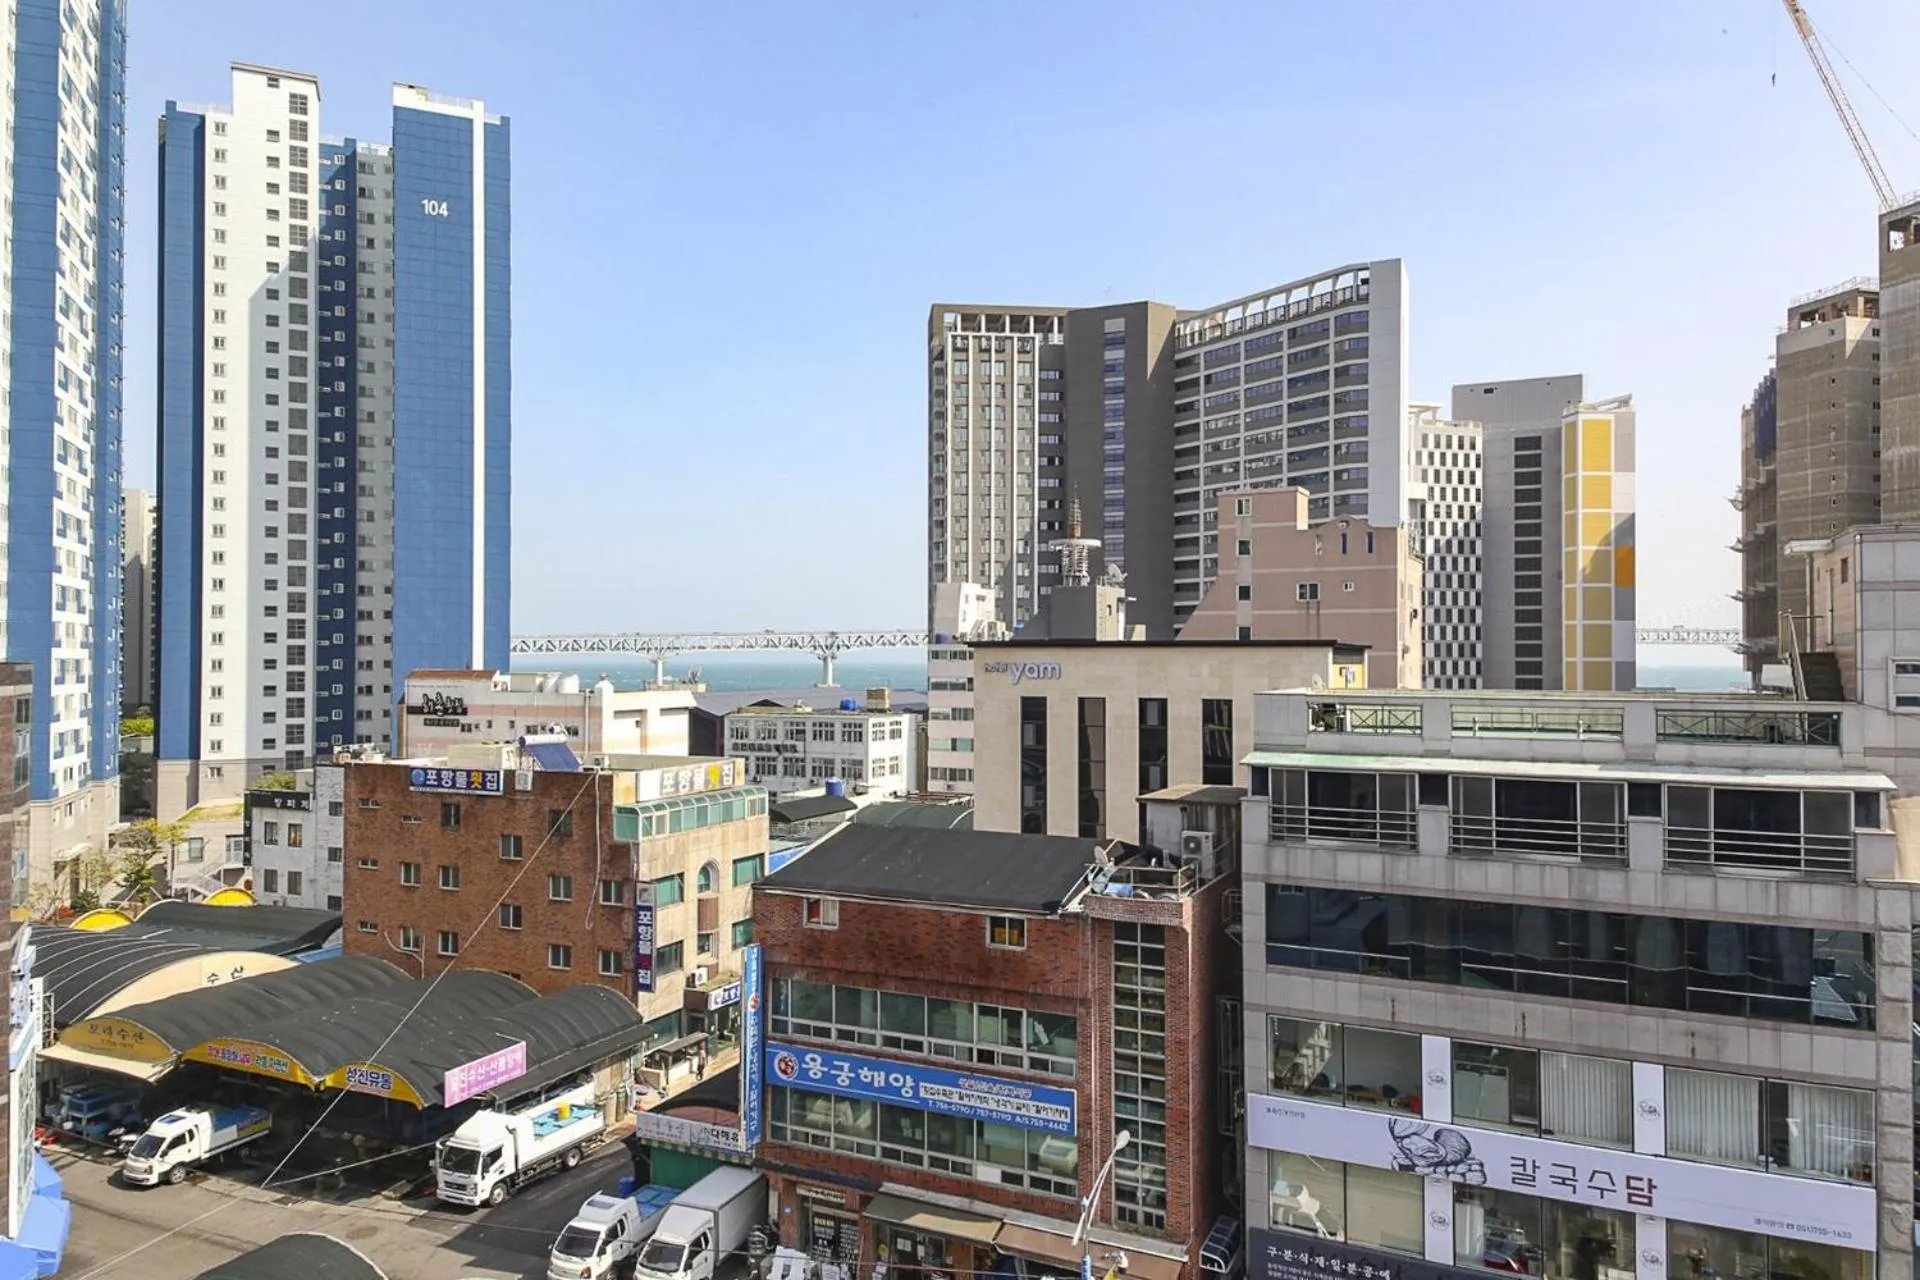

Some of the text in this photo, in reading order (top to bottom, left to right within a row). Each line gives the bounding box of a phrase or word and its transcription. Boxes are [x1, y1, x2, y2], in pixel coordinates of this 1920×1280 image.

[421, 199, 449, 218] 104
[1010, 662, 1062, 686] yam
[425, 769, 499, 791] 포항물횟집
[801, 1052, 916, 1098] 용궁해양
[1510, 1156, 1658, 1208] 칼국수담
